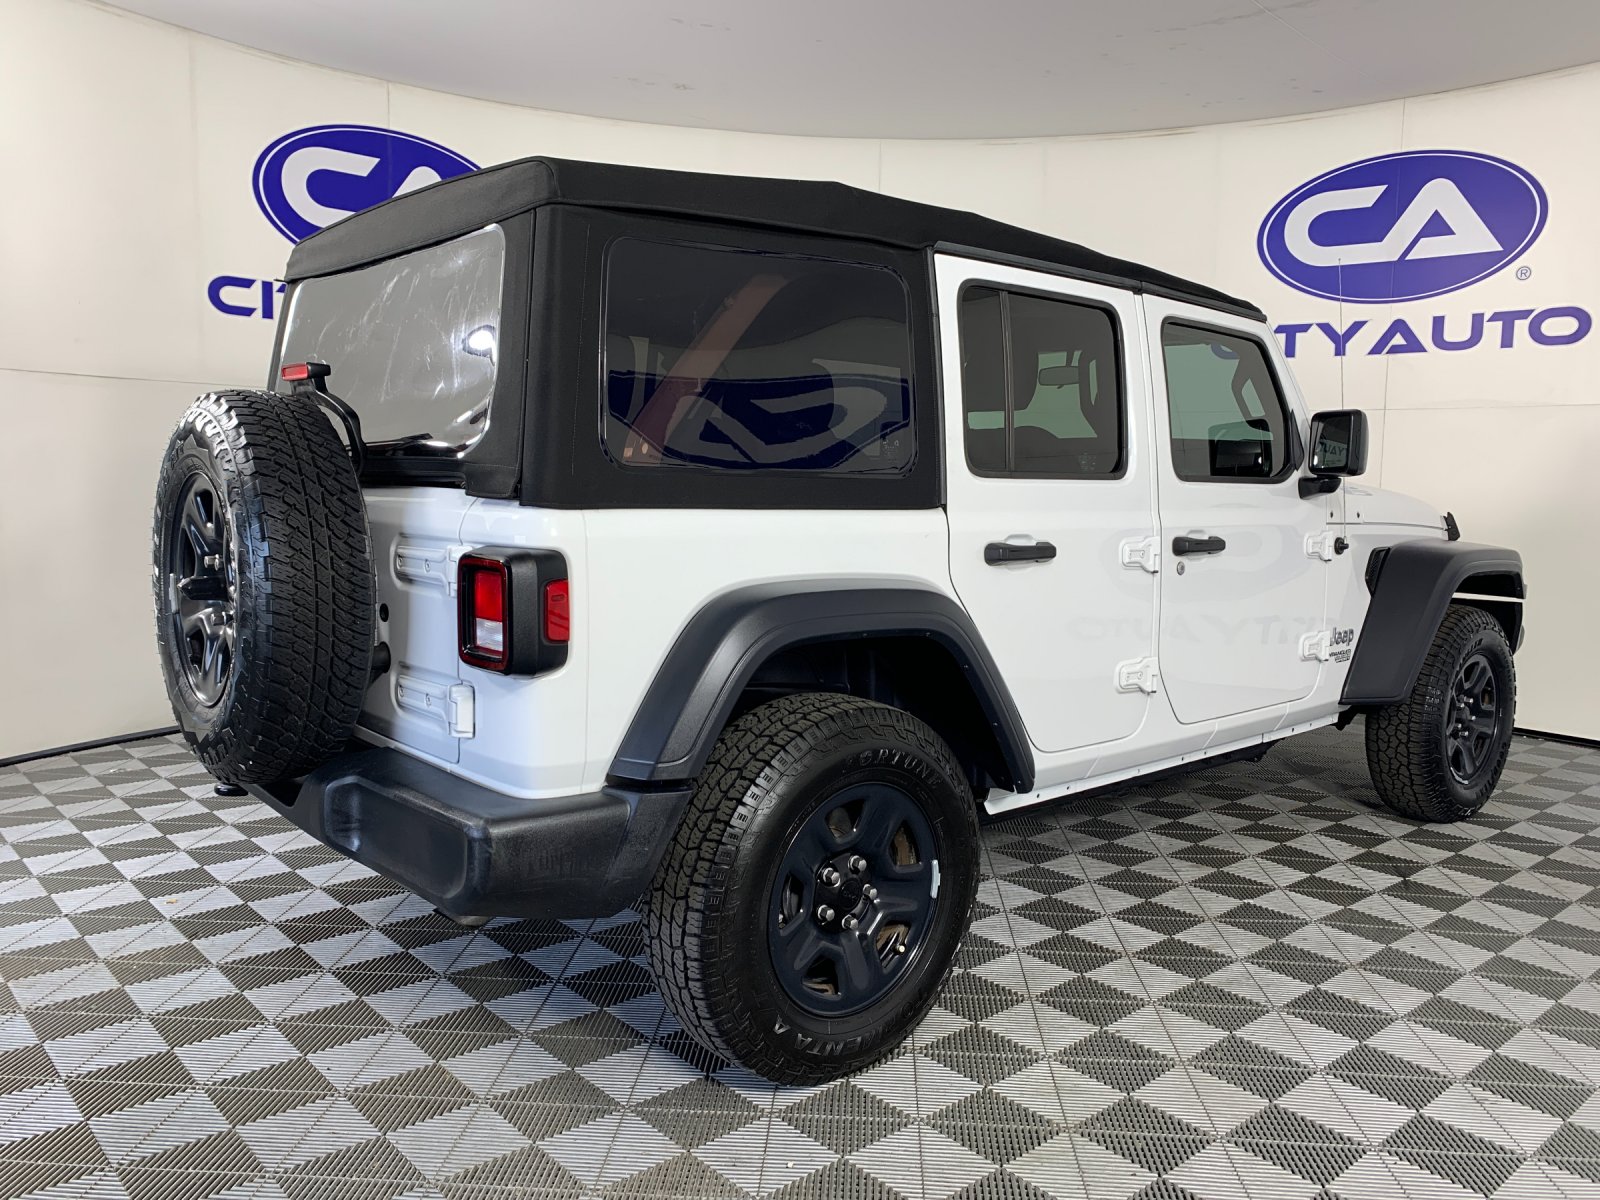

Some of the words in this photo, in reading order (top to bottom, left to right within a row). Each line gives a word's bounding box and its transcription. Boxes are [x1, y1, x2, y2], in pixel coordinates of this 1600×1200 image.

[1284, 177, 1504, 267] CA
[208, 275, 287, 319] CI
[1330, 627, 1354, 646] Jeep
